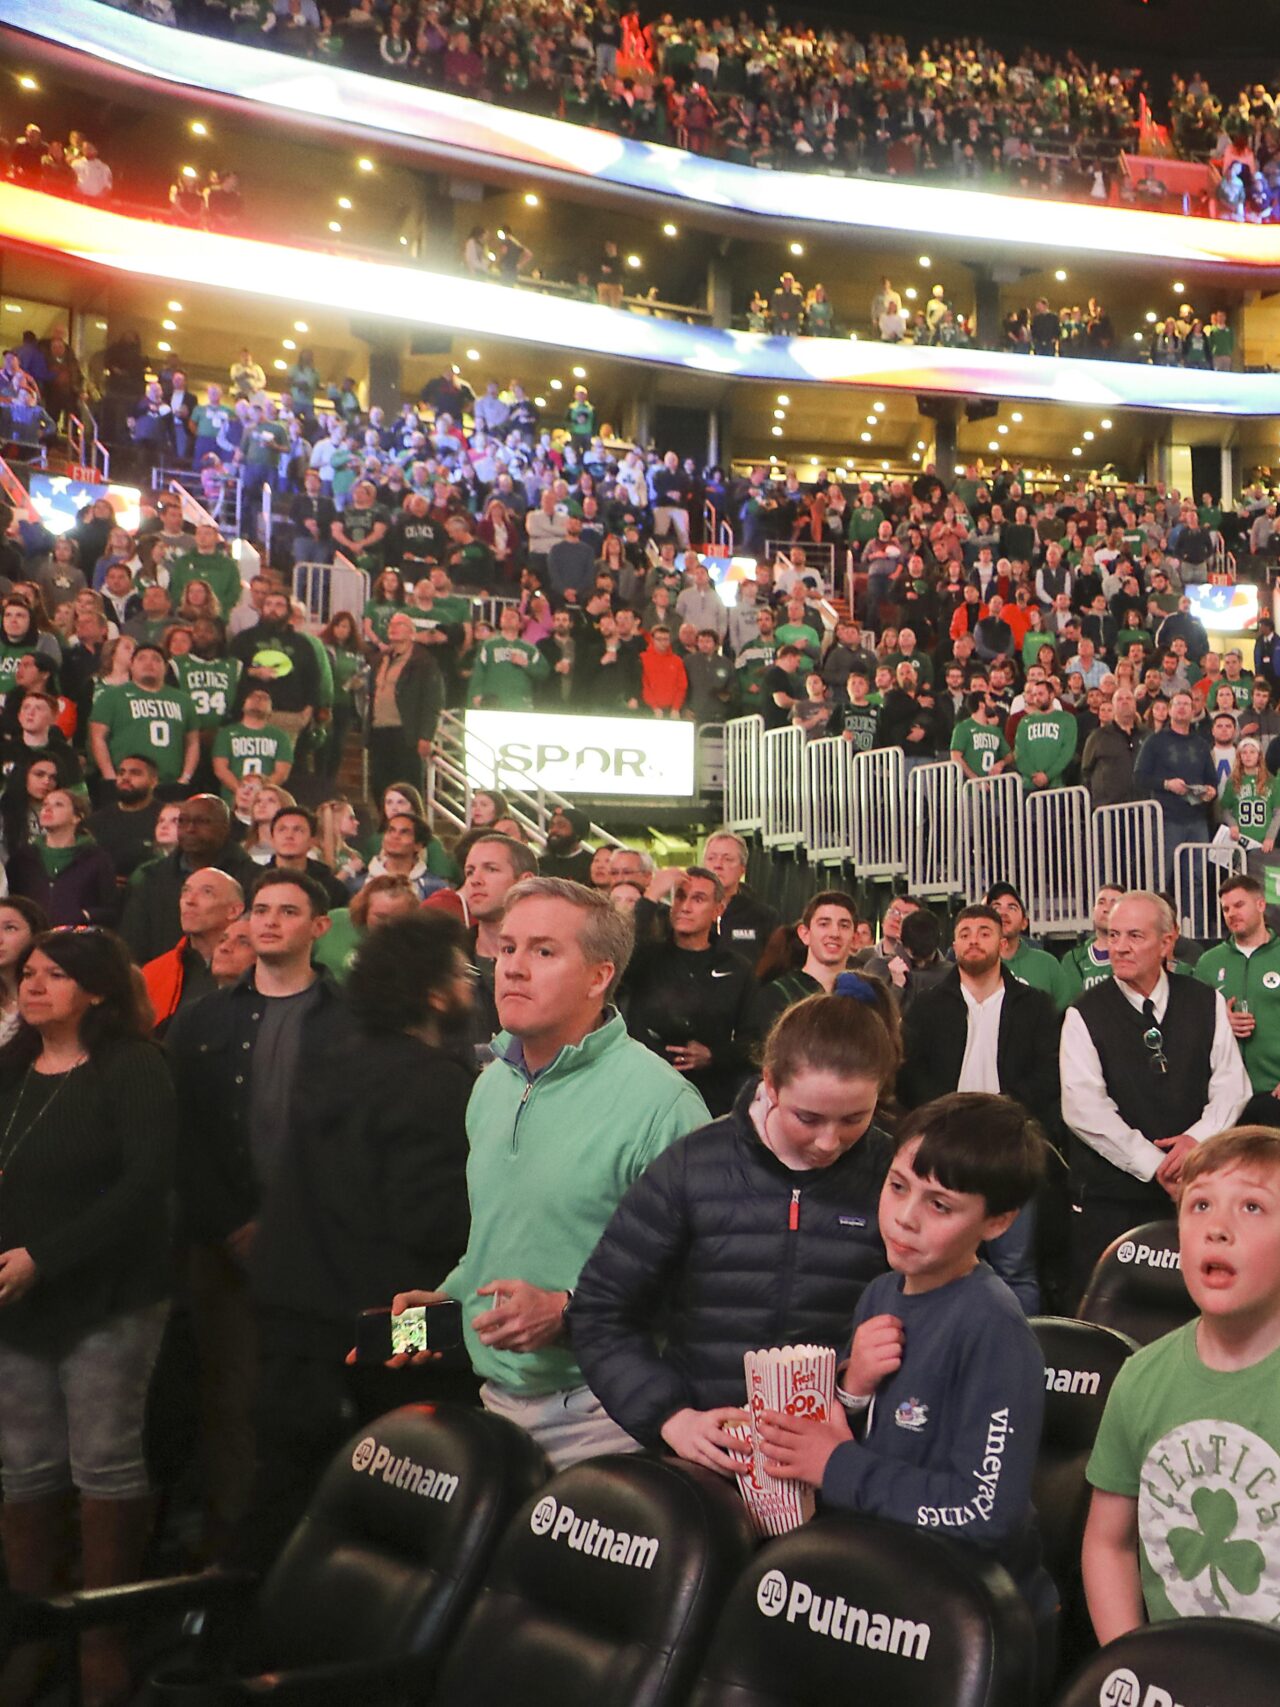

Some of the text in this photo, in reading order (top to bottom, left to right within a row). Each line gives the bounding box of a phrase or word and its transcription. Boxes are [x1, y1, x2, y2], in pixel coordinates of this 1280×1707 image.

[187, 671, 229, 691] CELTICS
[130, 699, 182, 721] BOSTON
[190, 690, 227, 716] 34
[150, 720, 170, 747] 0
[1027, 722, 1060, 740] CELTICS
[231, 737, 278, 757] BOSTON
[982, 751, 995, 773] 0
[1239, 801, 1266, 826] 99
[1134, 1245, 1181, 1270] Putn
[1043, 1367, 1101, 1395] nam
[785, 1394, 816, 1416] POP
[368, 1445, 459, 1503] Putnam
[551, 1505, 660, 1570] Putnam
[786, 1580, 932, 1661] Putnam
